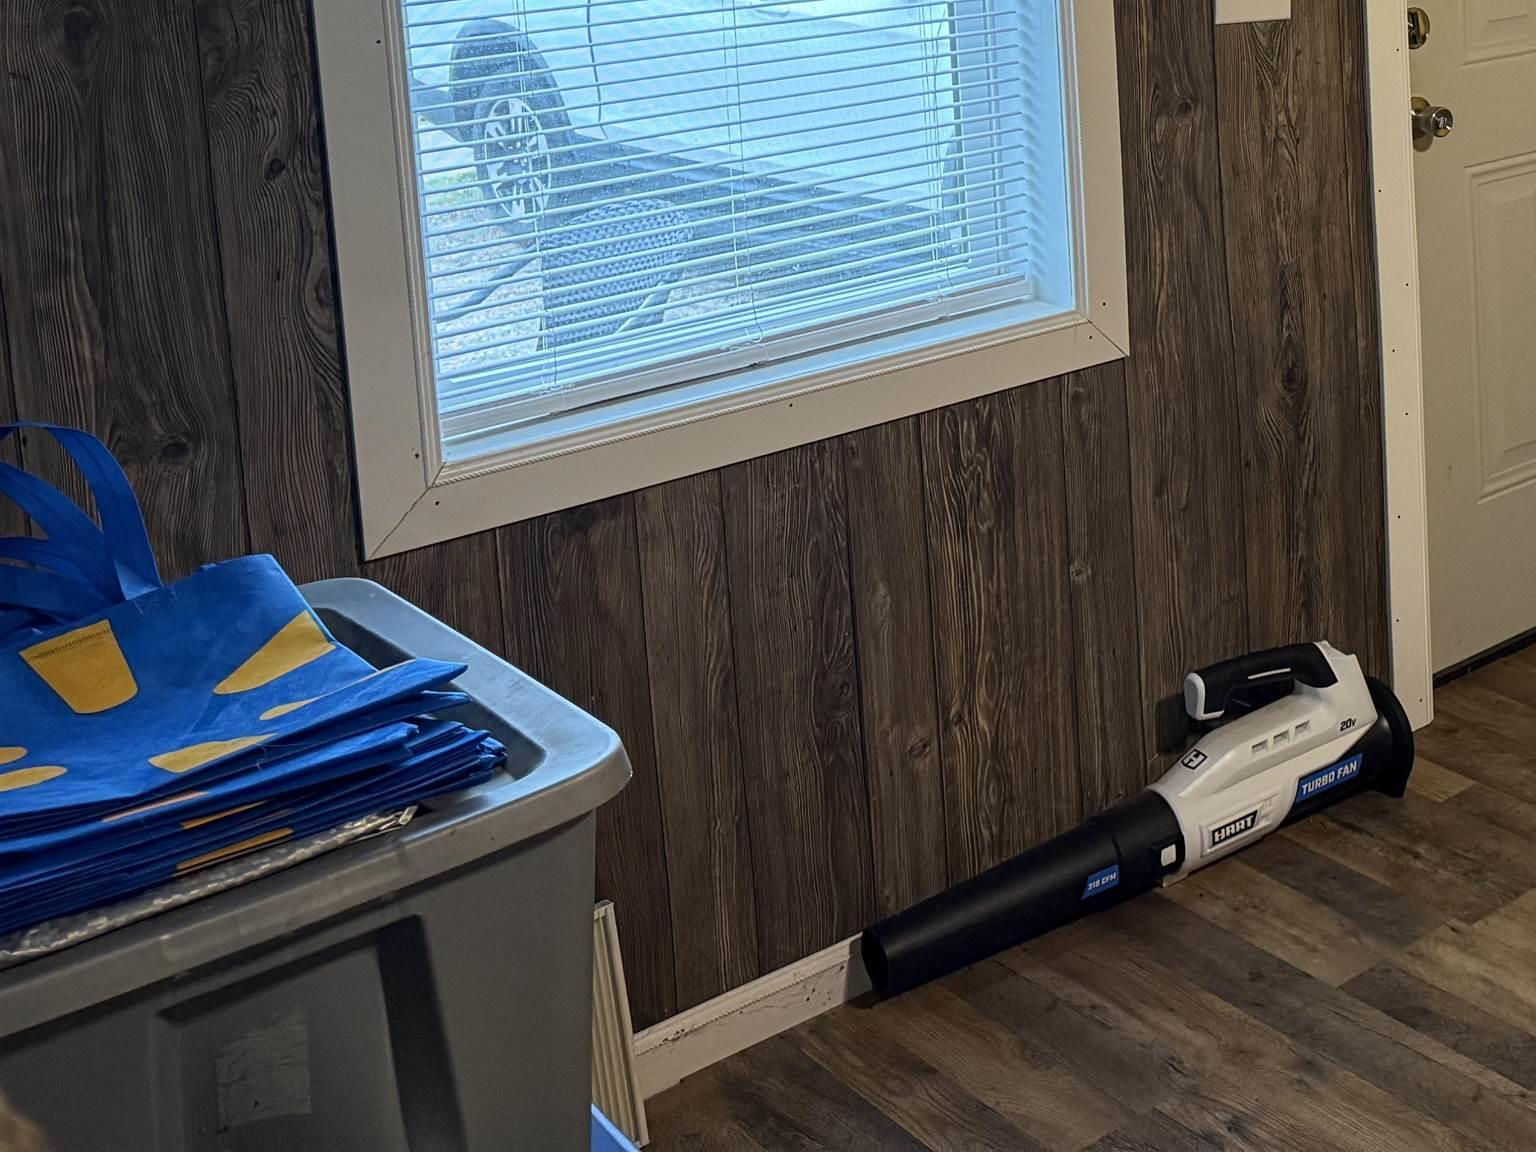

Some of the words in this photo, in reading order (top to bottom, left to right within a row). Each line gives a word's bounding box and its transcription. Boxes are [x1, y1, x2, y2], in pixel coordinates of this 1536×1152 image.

[1302, 771, 1335, 795] TURBO
[1337, 760, 1357, 779] FAN
[1214, 815, 1254, 843] HART
